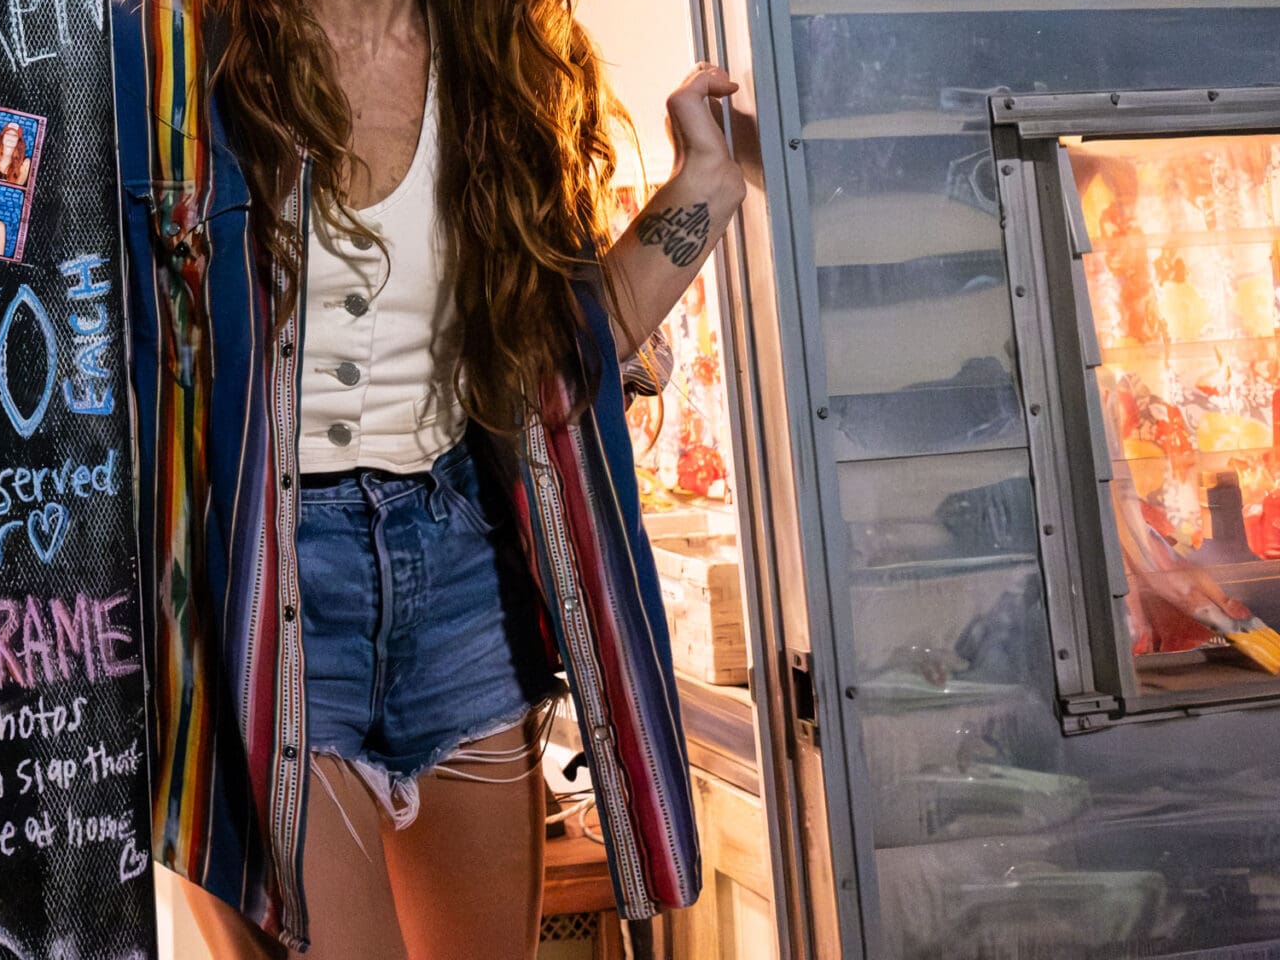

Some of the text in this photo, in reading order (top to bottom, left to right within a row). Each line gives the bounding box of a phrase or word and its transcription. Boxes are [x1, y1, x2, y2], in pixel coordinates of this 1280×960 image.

[60, 253, 116, 416] EACH
[83, 739, 144, 785] that
[25, 810, 57, 849] at
[67, 805, 137, 849] home
